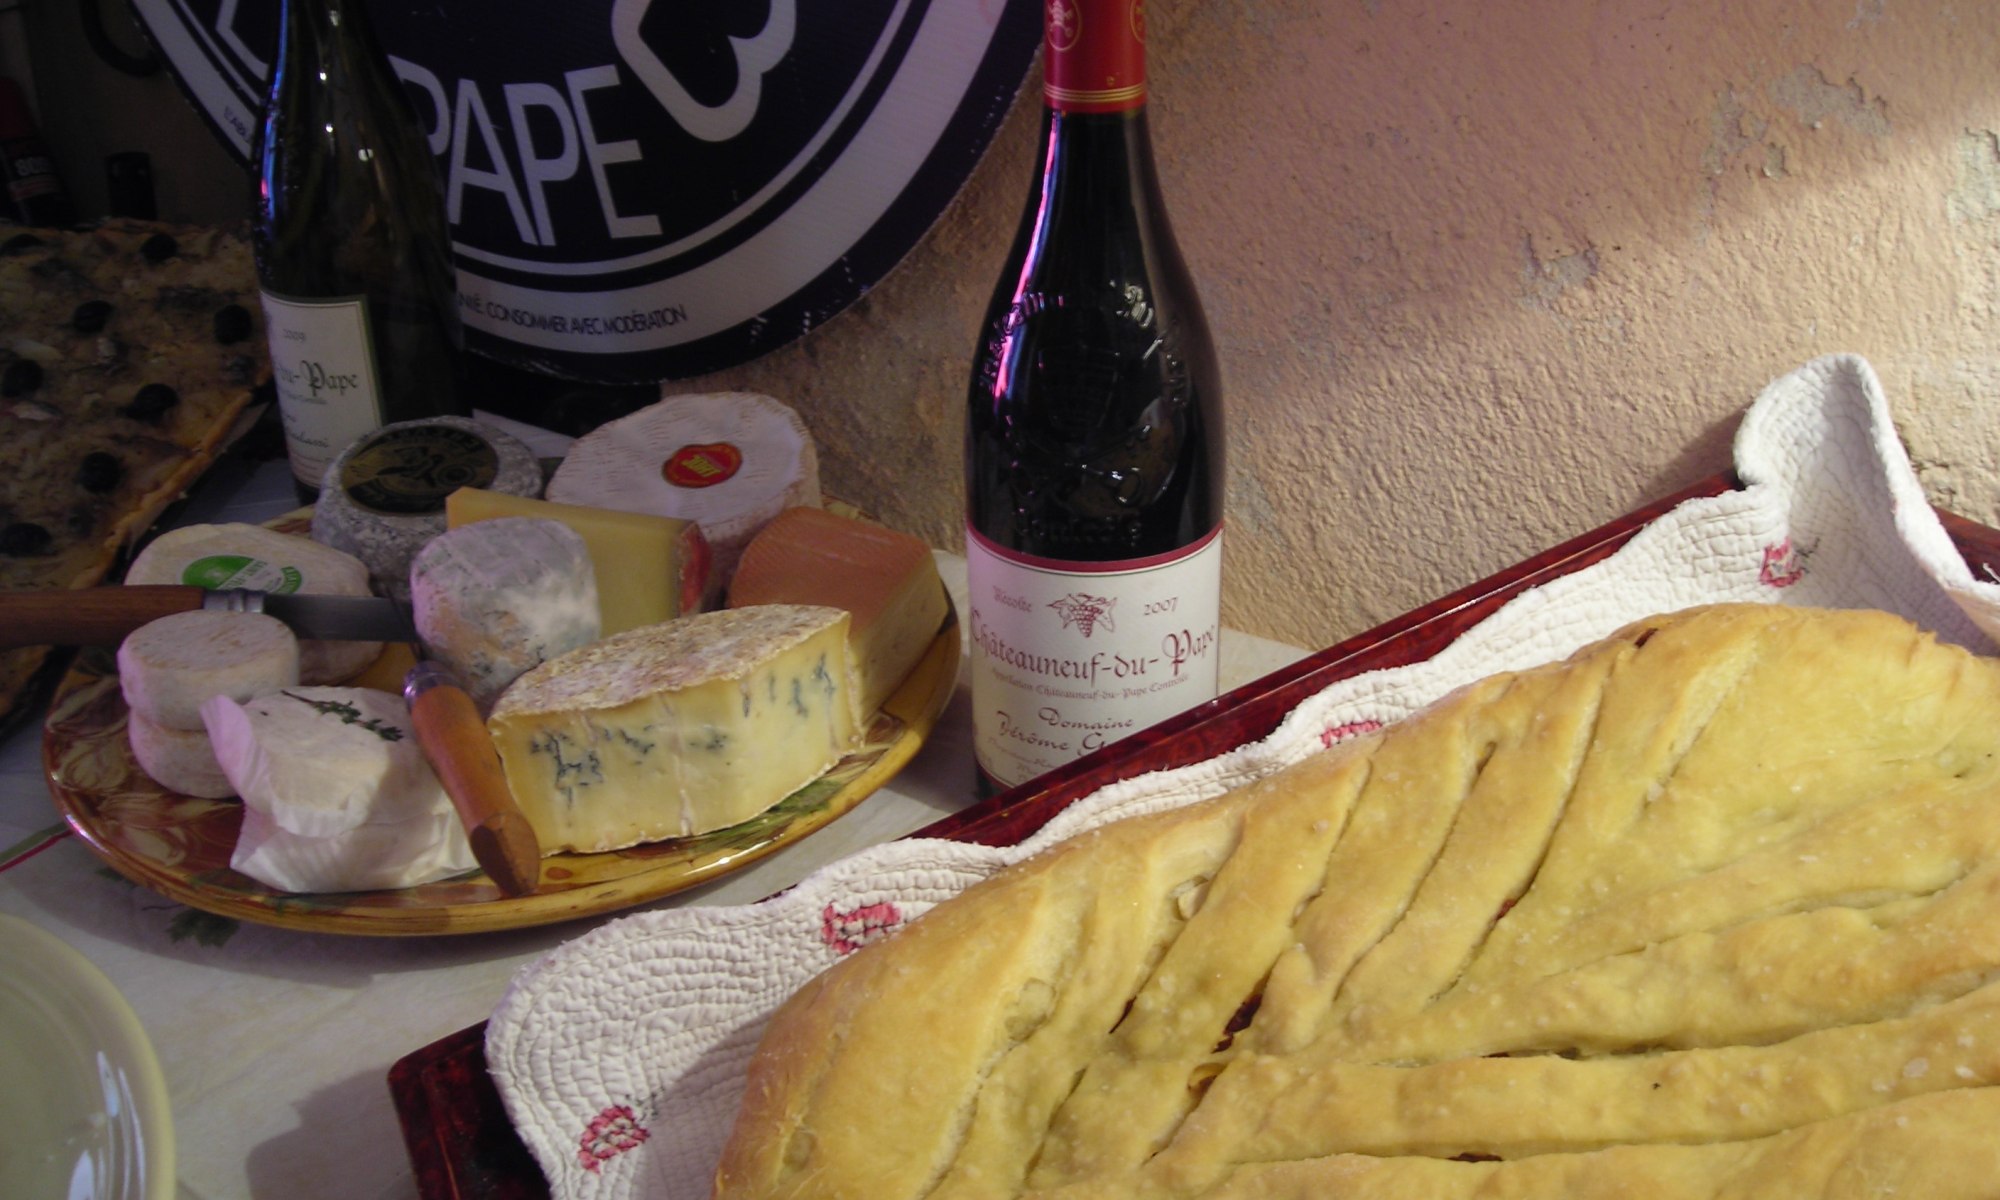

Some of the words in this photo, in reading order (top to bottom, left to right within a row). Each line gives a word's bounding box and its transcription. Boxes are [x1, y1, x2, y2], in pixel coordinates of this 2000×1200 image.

[486, 302, 569, 334] CONSOMMER
[571, 317, 602, 335] AVEC
[603, 303, 688, 334] MODÉRATION
[1144, 597, 1179, 615] 2007
[996, 710, 1070, 751] Jérôme
[1038, 706, 1134, 730] Domaine
